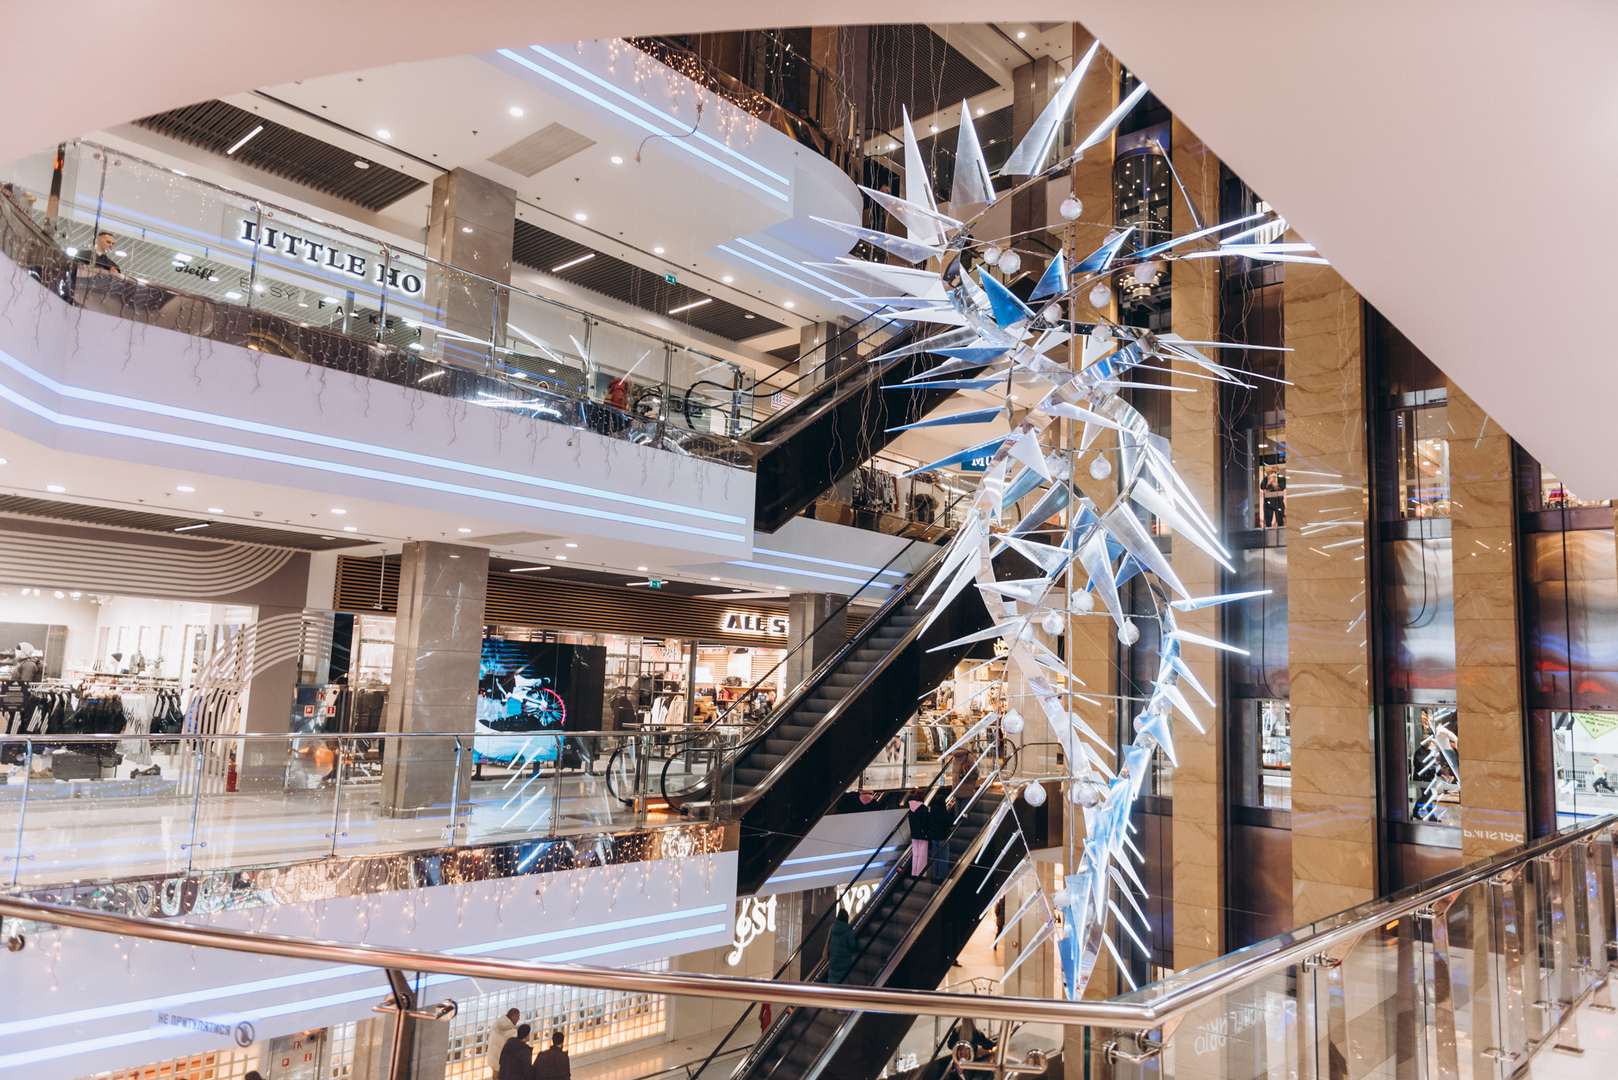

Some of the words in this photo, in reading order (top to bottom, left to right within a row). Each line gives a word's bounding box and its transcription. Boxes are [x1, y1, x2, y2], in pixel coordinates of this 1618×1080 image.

[241, 220, 366, 277] LITTLE
[727, 615, 766, 632] ALL
[773, 619, 789, 633] S
[157, 1012, 169, 1025] НЕ
[170, 1014, 232, 1036] ПРИТУЛЯТИСЯ
